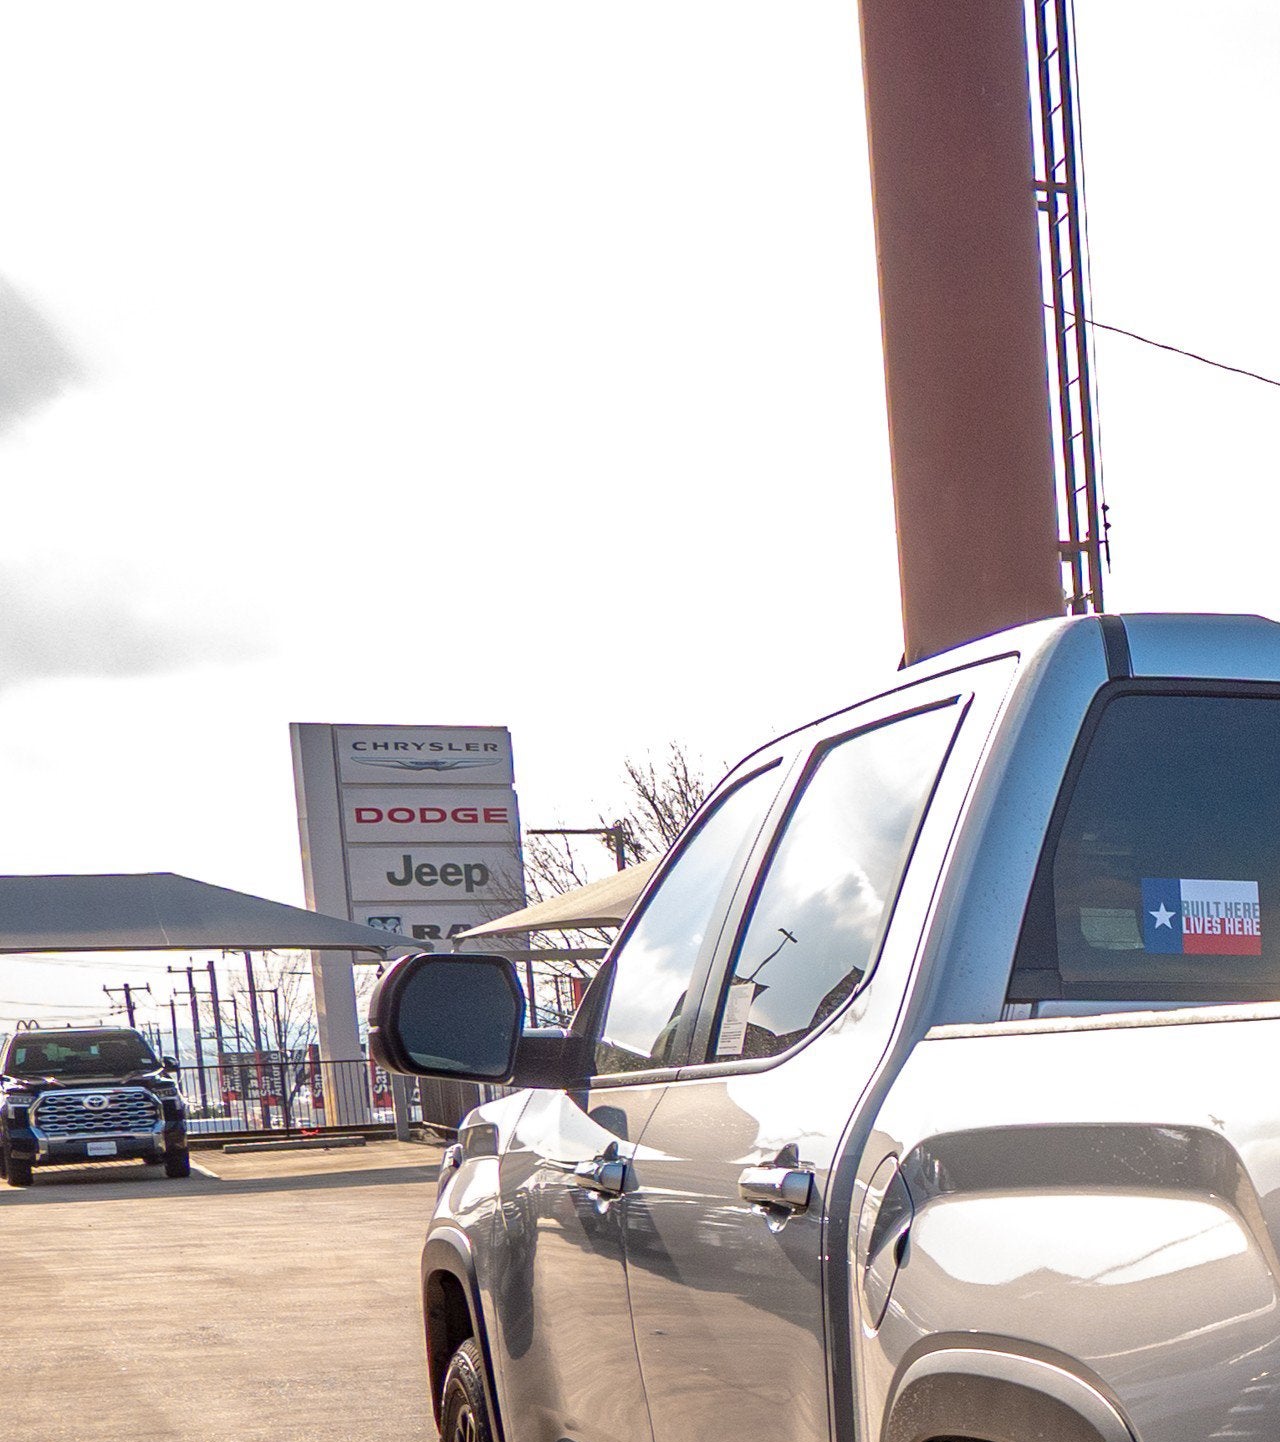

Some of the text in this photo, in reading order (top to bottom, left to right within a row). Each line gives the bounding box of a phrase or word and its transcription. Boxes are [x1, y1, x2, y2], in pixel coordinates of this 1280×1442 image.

[352, 741, 499, 753] CHRYSLER
[355, 807, 509, 824] DODGE
[386, 855, 490, 893] Jeep
[1182, 900, 1260, 919] BUILT HERE
[1182, 917, 1262, 936] LIVES HERE
[373, 1065, 389, 1095] San
